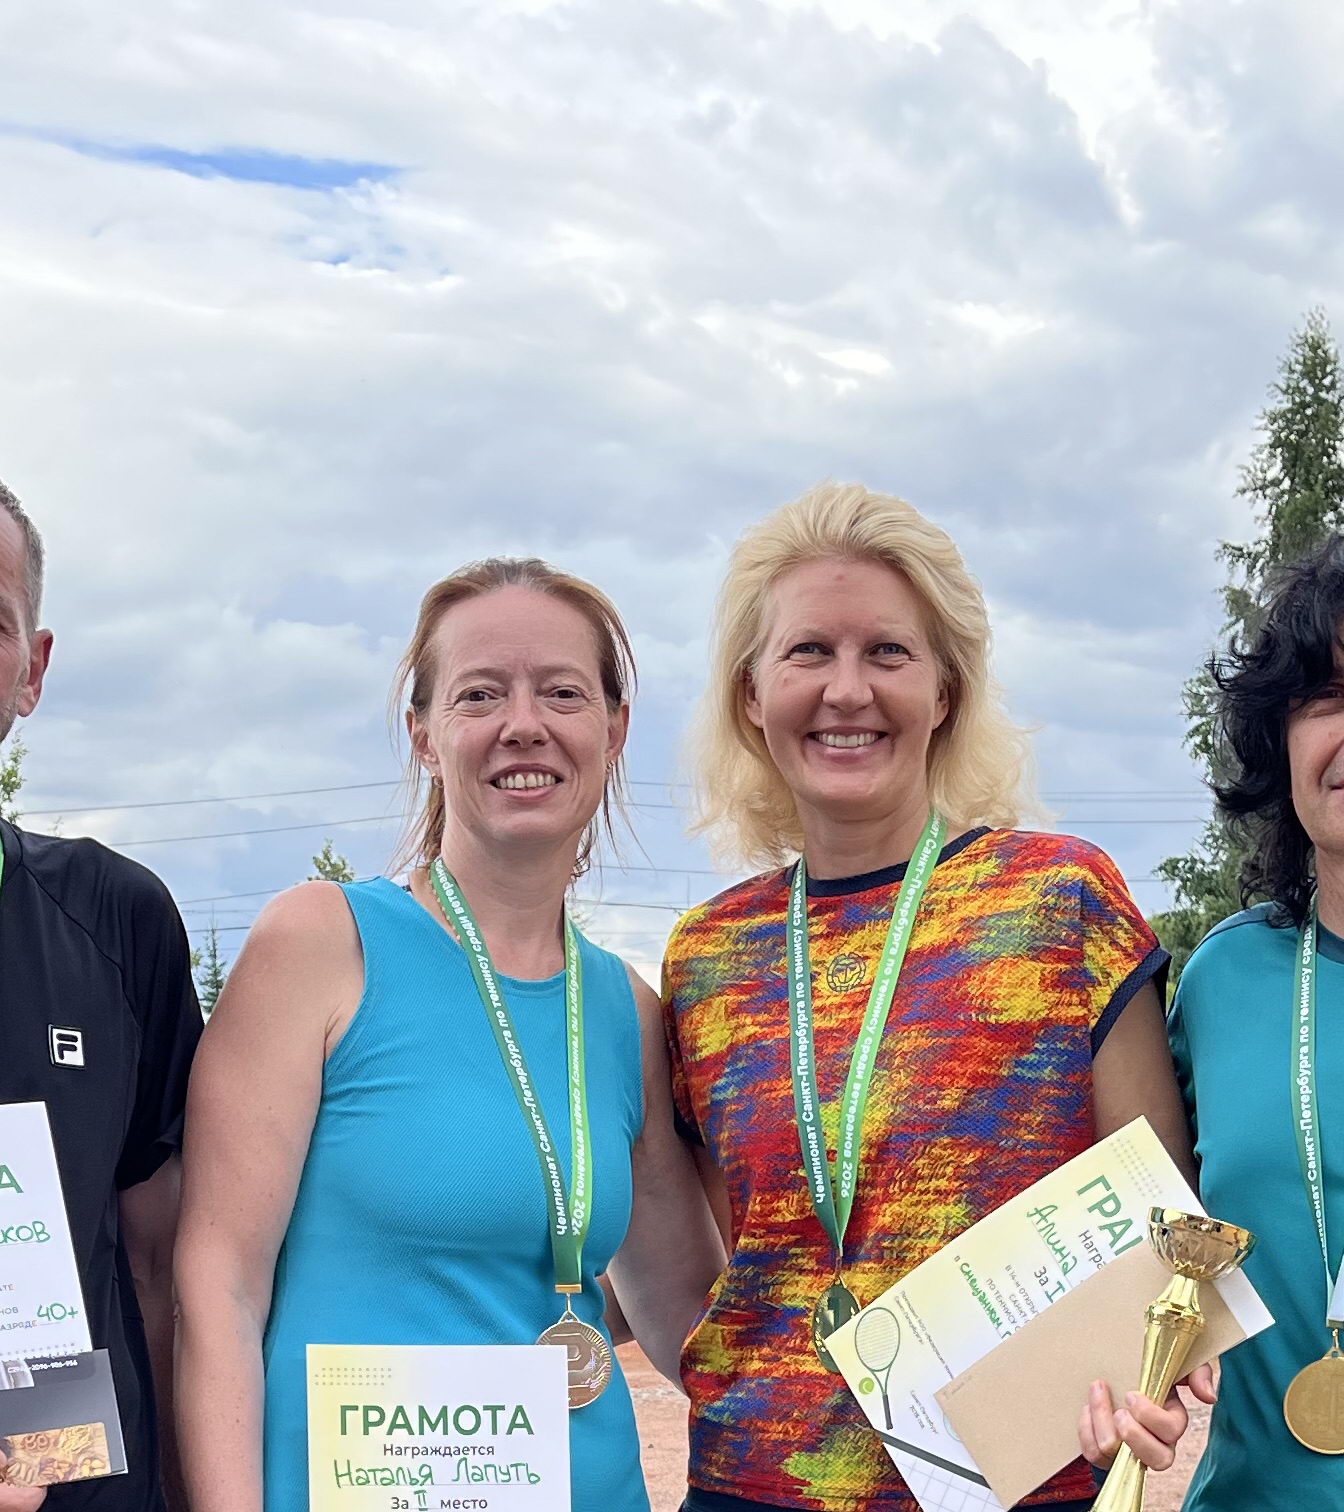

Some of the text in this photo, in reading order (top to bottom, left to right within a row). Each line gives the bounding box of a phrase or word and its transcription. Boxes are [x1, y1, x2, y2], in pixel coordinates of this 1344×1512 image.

[889, 839, 937, 955] Санкт-Петербурга
[459, 915, 482, 951] среди
[793, 928, 804, 980] теннису
[884, 959, 896, 975] по
[476, 954, 502, 1008] теннису
[795, 981, 805, 998] по
[1299, 968, 1313, 1023] теннису
[496, 1010, 508, 1027] по
[865, 978, 891, 1033] теннису
[1299, 1025, 1309, 1042] по
[795, 1000, 814, 1122] Санкт-Петербурга
[855, 1038, 874, 1080] среди
[502, 1030, 552, 1152] Санкт-Петербурга
[843, 1083, 862, 1158] ветеранов
[1296, 1046, 1318, 1181] Санкт-Петербурга
[806, 1125, 825, 1203] Чемпионат
[840, 1162, 853, 1198] 2026
[546, 1155, 567, 1235] Чемпионат
[1034, 1266, 1049, 1287] За
[36, 1303, 79, 1321] 40+
[995, 1290, 1018, 1325] ТЕННИСУ
[340, 1404, 535, 1436] ГРАМОТА
[383, 1443, 495, 1458] Награждается
[333, 1457, 541, 1488] Наталья Лапуть
[391, 1497, 409, 1510] За
[440, 1497, 488, 1510] место
